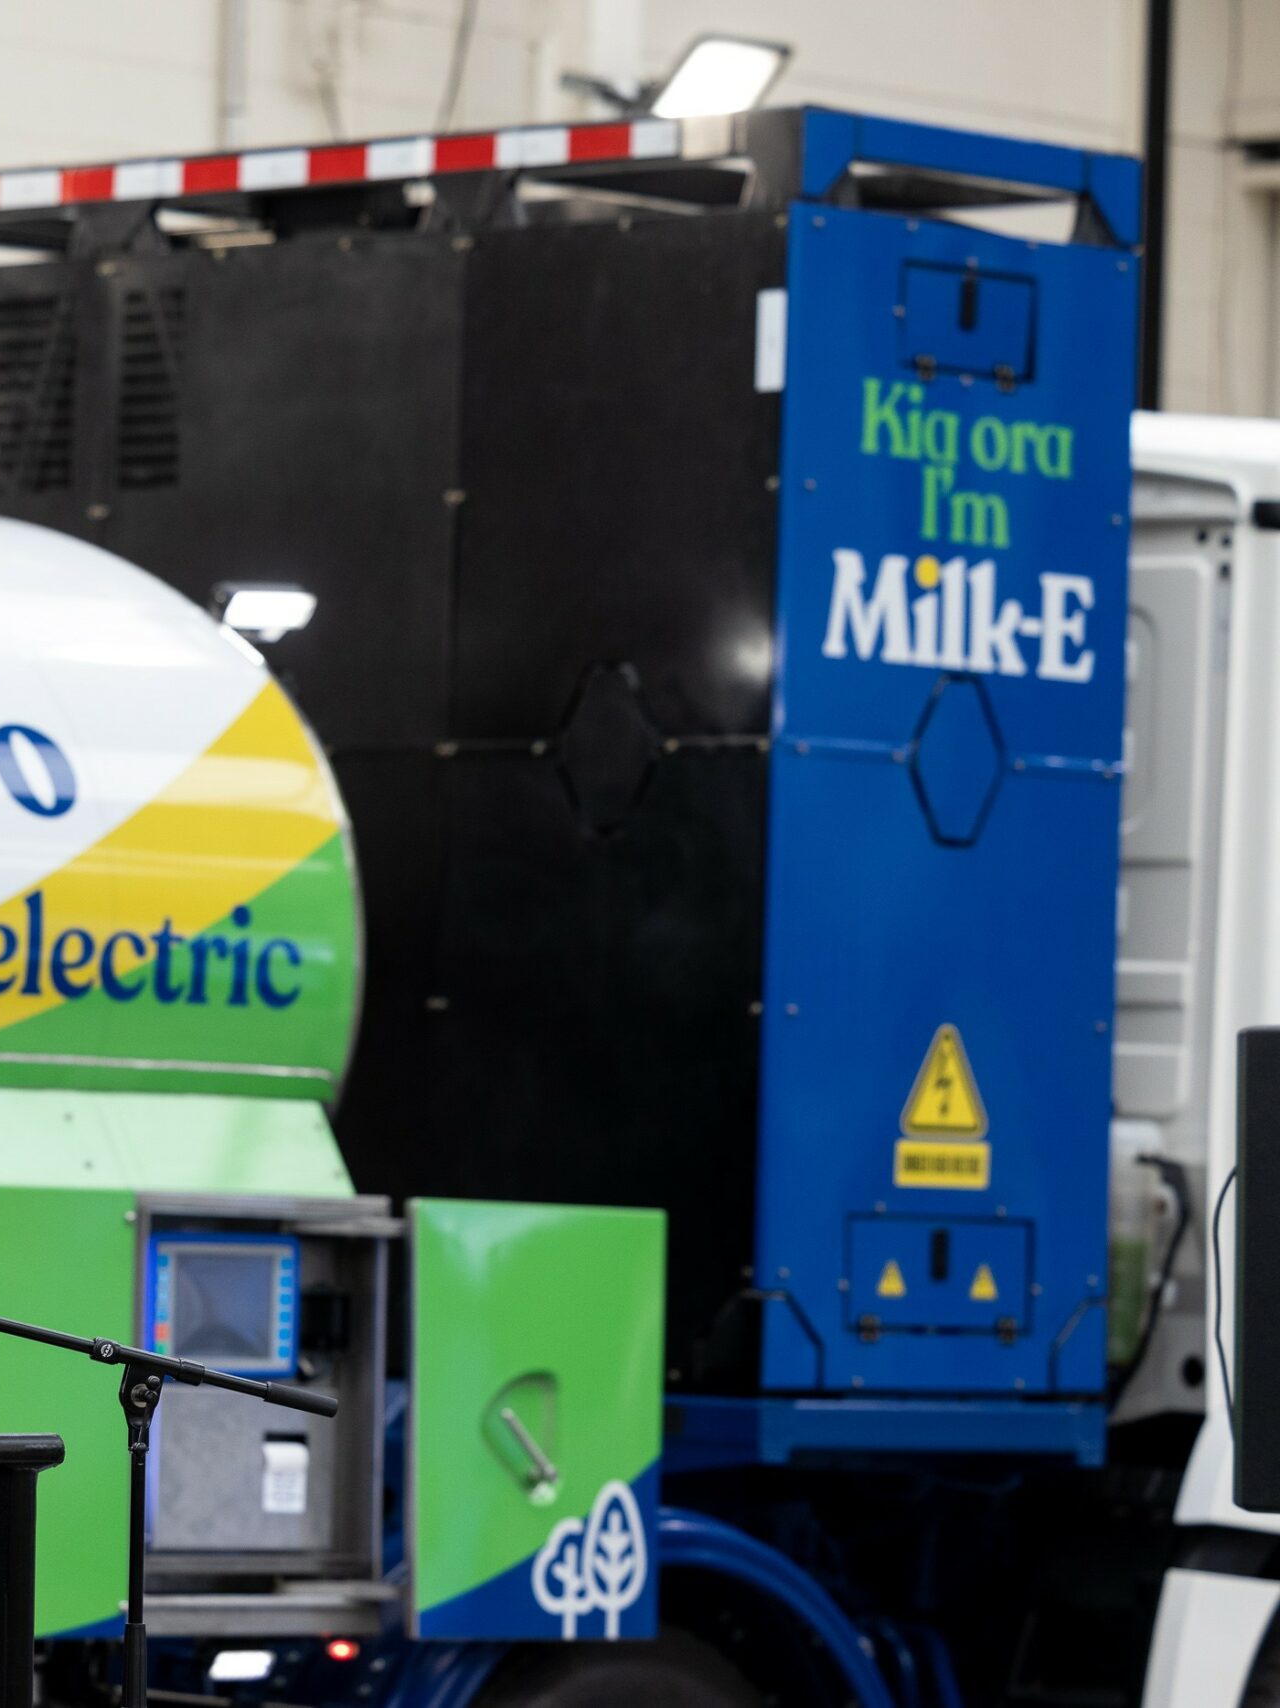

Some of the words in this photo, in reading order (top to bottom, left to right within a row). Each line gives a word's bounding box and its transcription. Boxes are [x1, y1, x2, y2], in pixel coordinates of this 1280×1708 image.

[860, 377, 960, 467] Kia
[970, 415, 1073, 479] ora
[921, 464, 1010, 549] I'm
[821, 546, 1095, 683] Milk-E
